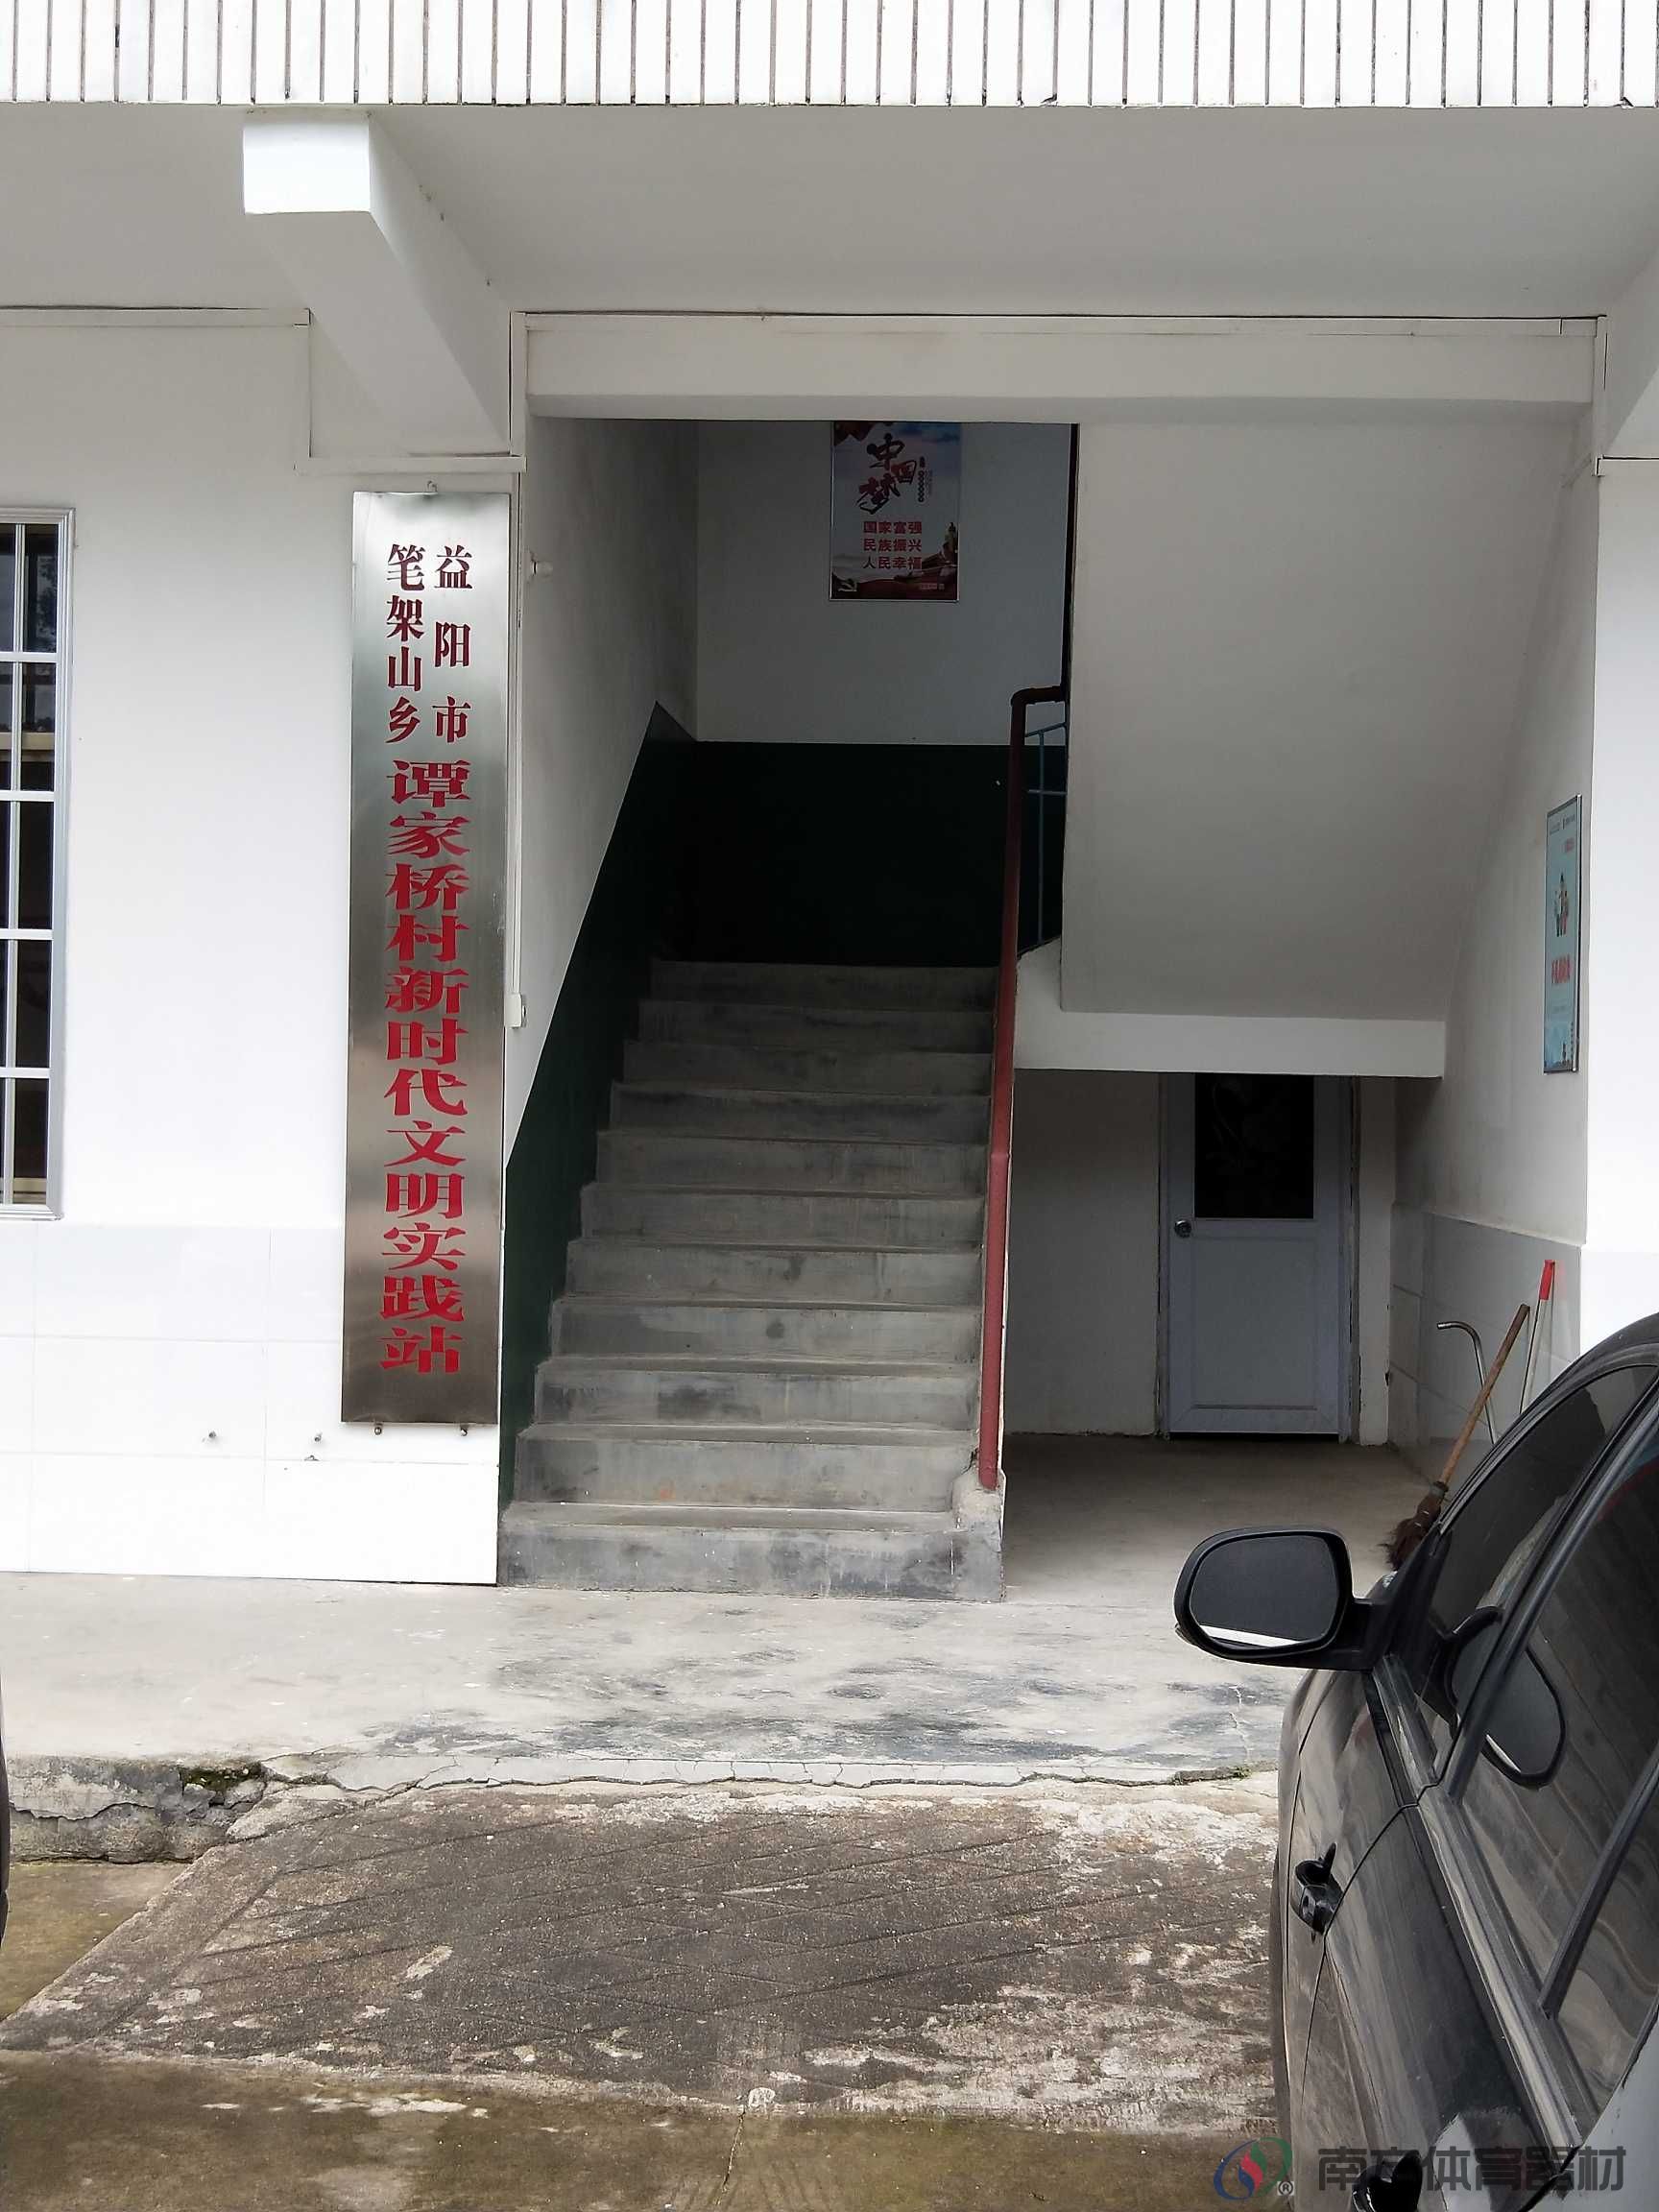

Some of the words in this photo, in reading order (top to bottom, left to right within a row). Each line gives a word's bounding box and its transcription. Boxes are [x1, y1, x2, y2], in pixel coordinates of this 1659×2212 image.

[863, 521, 922, 535] 国家富强
[863, 539, 922, 552] 民族振兴
[863, 556, 922, 570] 人民幸福
[386, 544, 425, 744] 笔架山乡
[432, 544, 472, 743] 益阳市
[379, 758, 471, 1374] 谭家桥村新时代文明实践站
